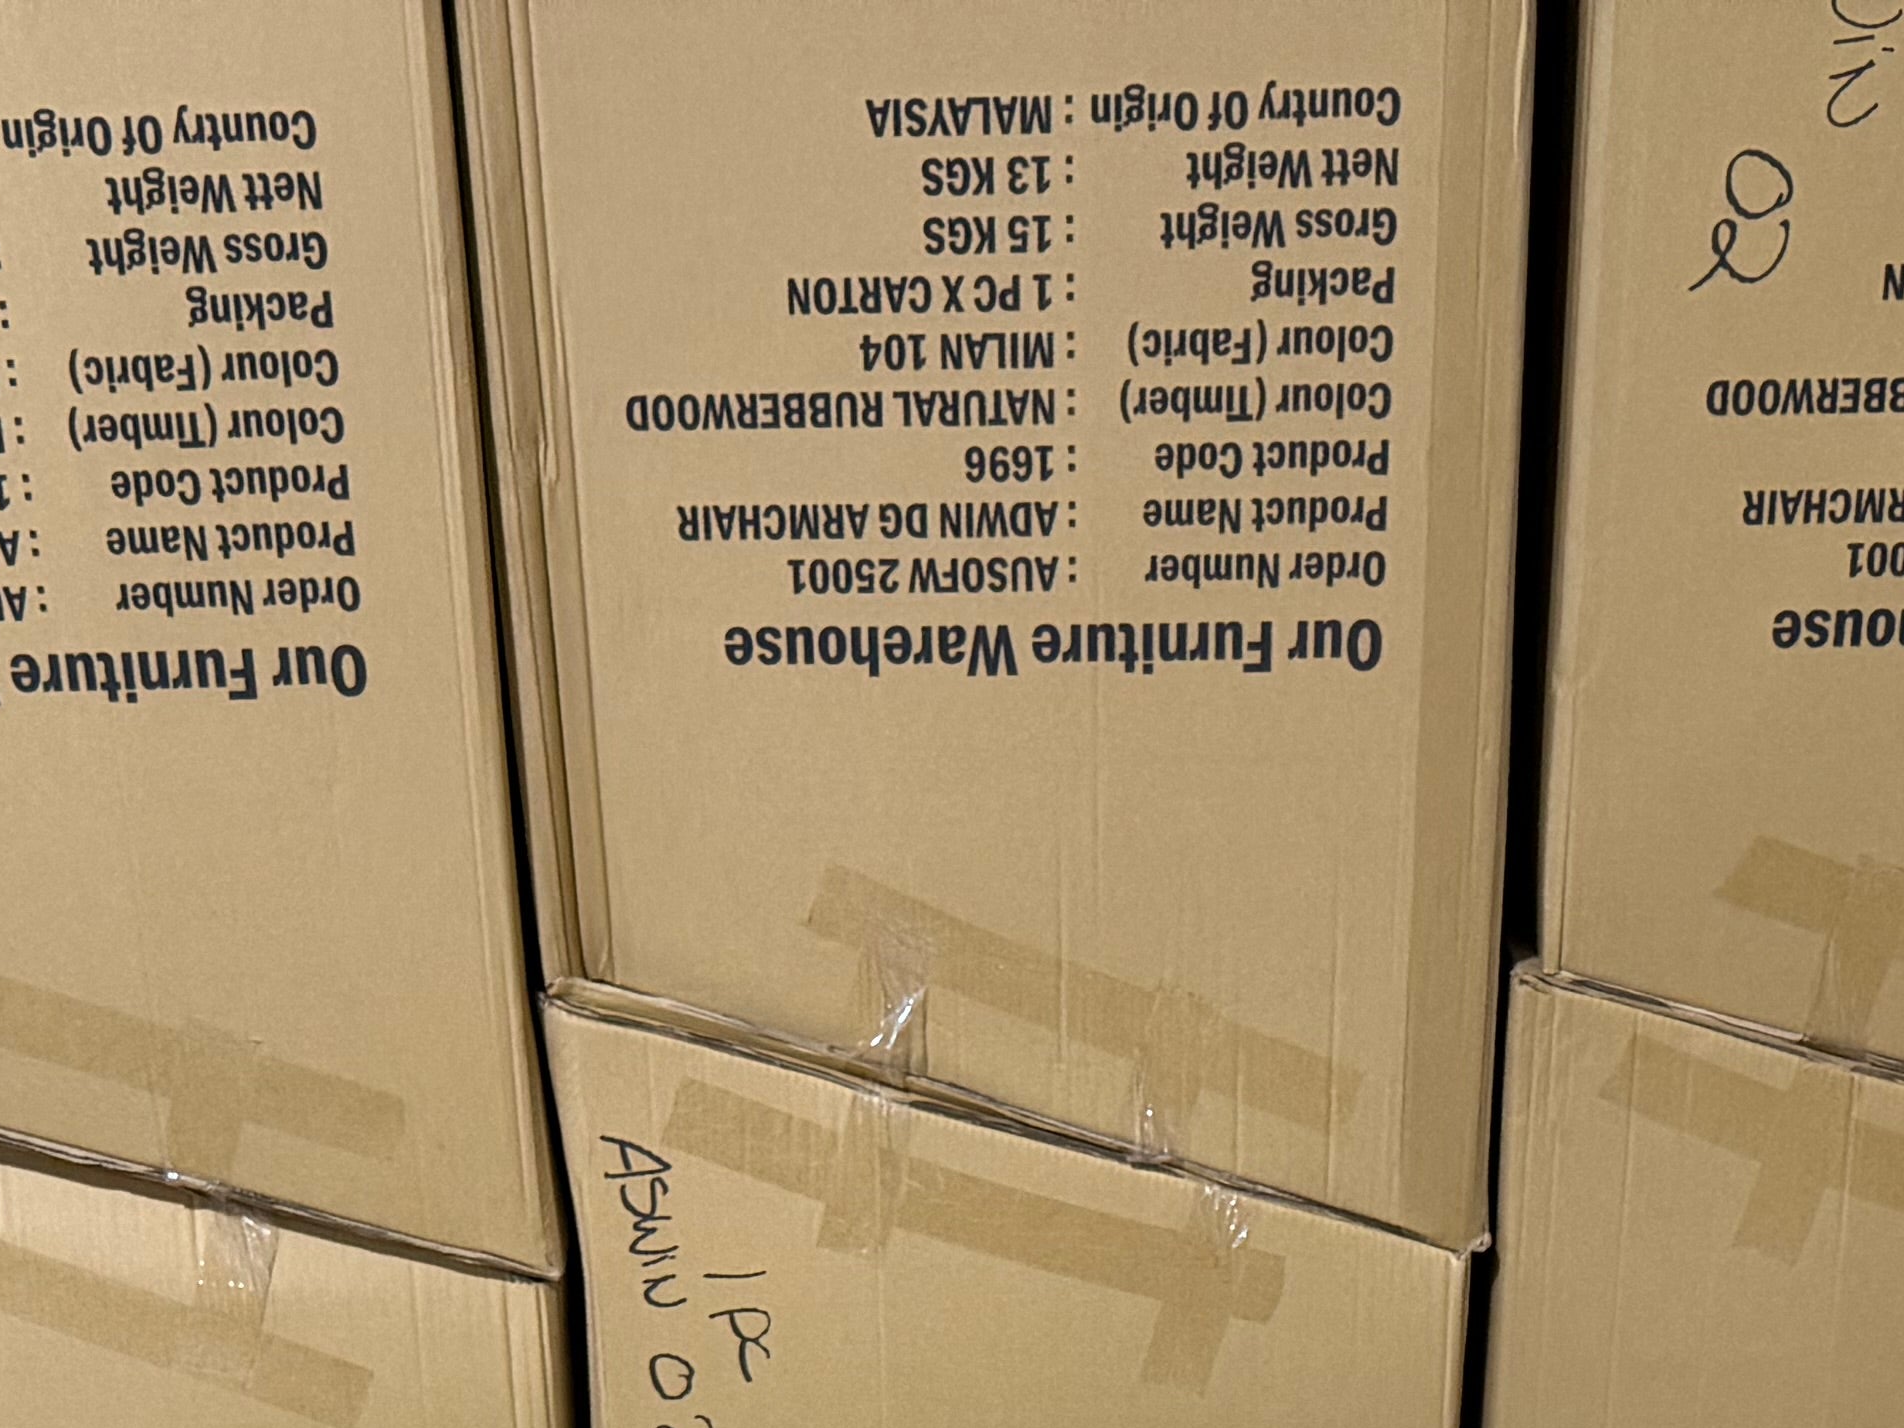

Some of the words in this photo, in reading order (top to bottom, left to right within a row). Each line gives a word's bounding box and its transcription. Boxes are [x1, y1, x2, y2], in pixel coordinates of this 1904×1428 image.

[922, 215, 995, 254] KGS
[1007, 214, 1051, 253] 15
[1159, 201, 1285, 249] Weight
[1295, 206, 1396, 245] Gross
[625, 390, 882, 431] RUBBERWOOD
[891, 387, 1054, 426] NATURAL
[1119, 375, 1266, 423] (Timber)
[1274, 381, 1391, 419] Colour
[67, 401, 217, 452] (Timber)
[226, 406, 344, 444] Colour
[105, 524, 207, 560] Name
[214, 519, 355, 559] Product
[723, 623, 1017, 676] Warehouse
[1030, 620, 1272, 674] Furniture
[1286, 617, 1381, 670] Our
[9, 647, 257, 703] Furniture
[271, 643, 367, 696] Our
